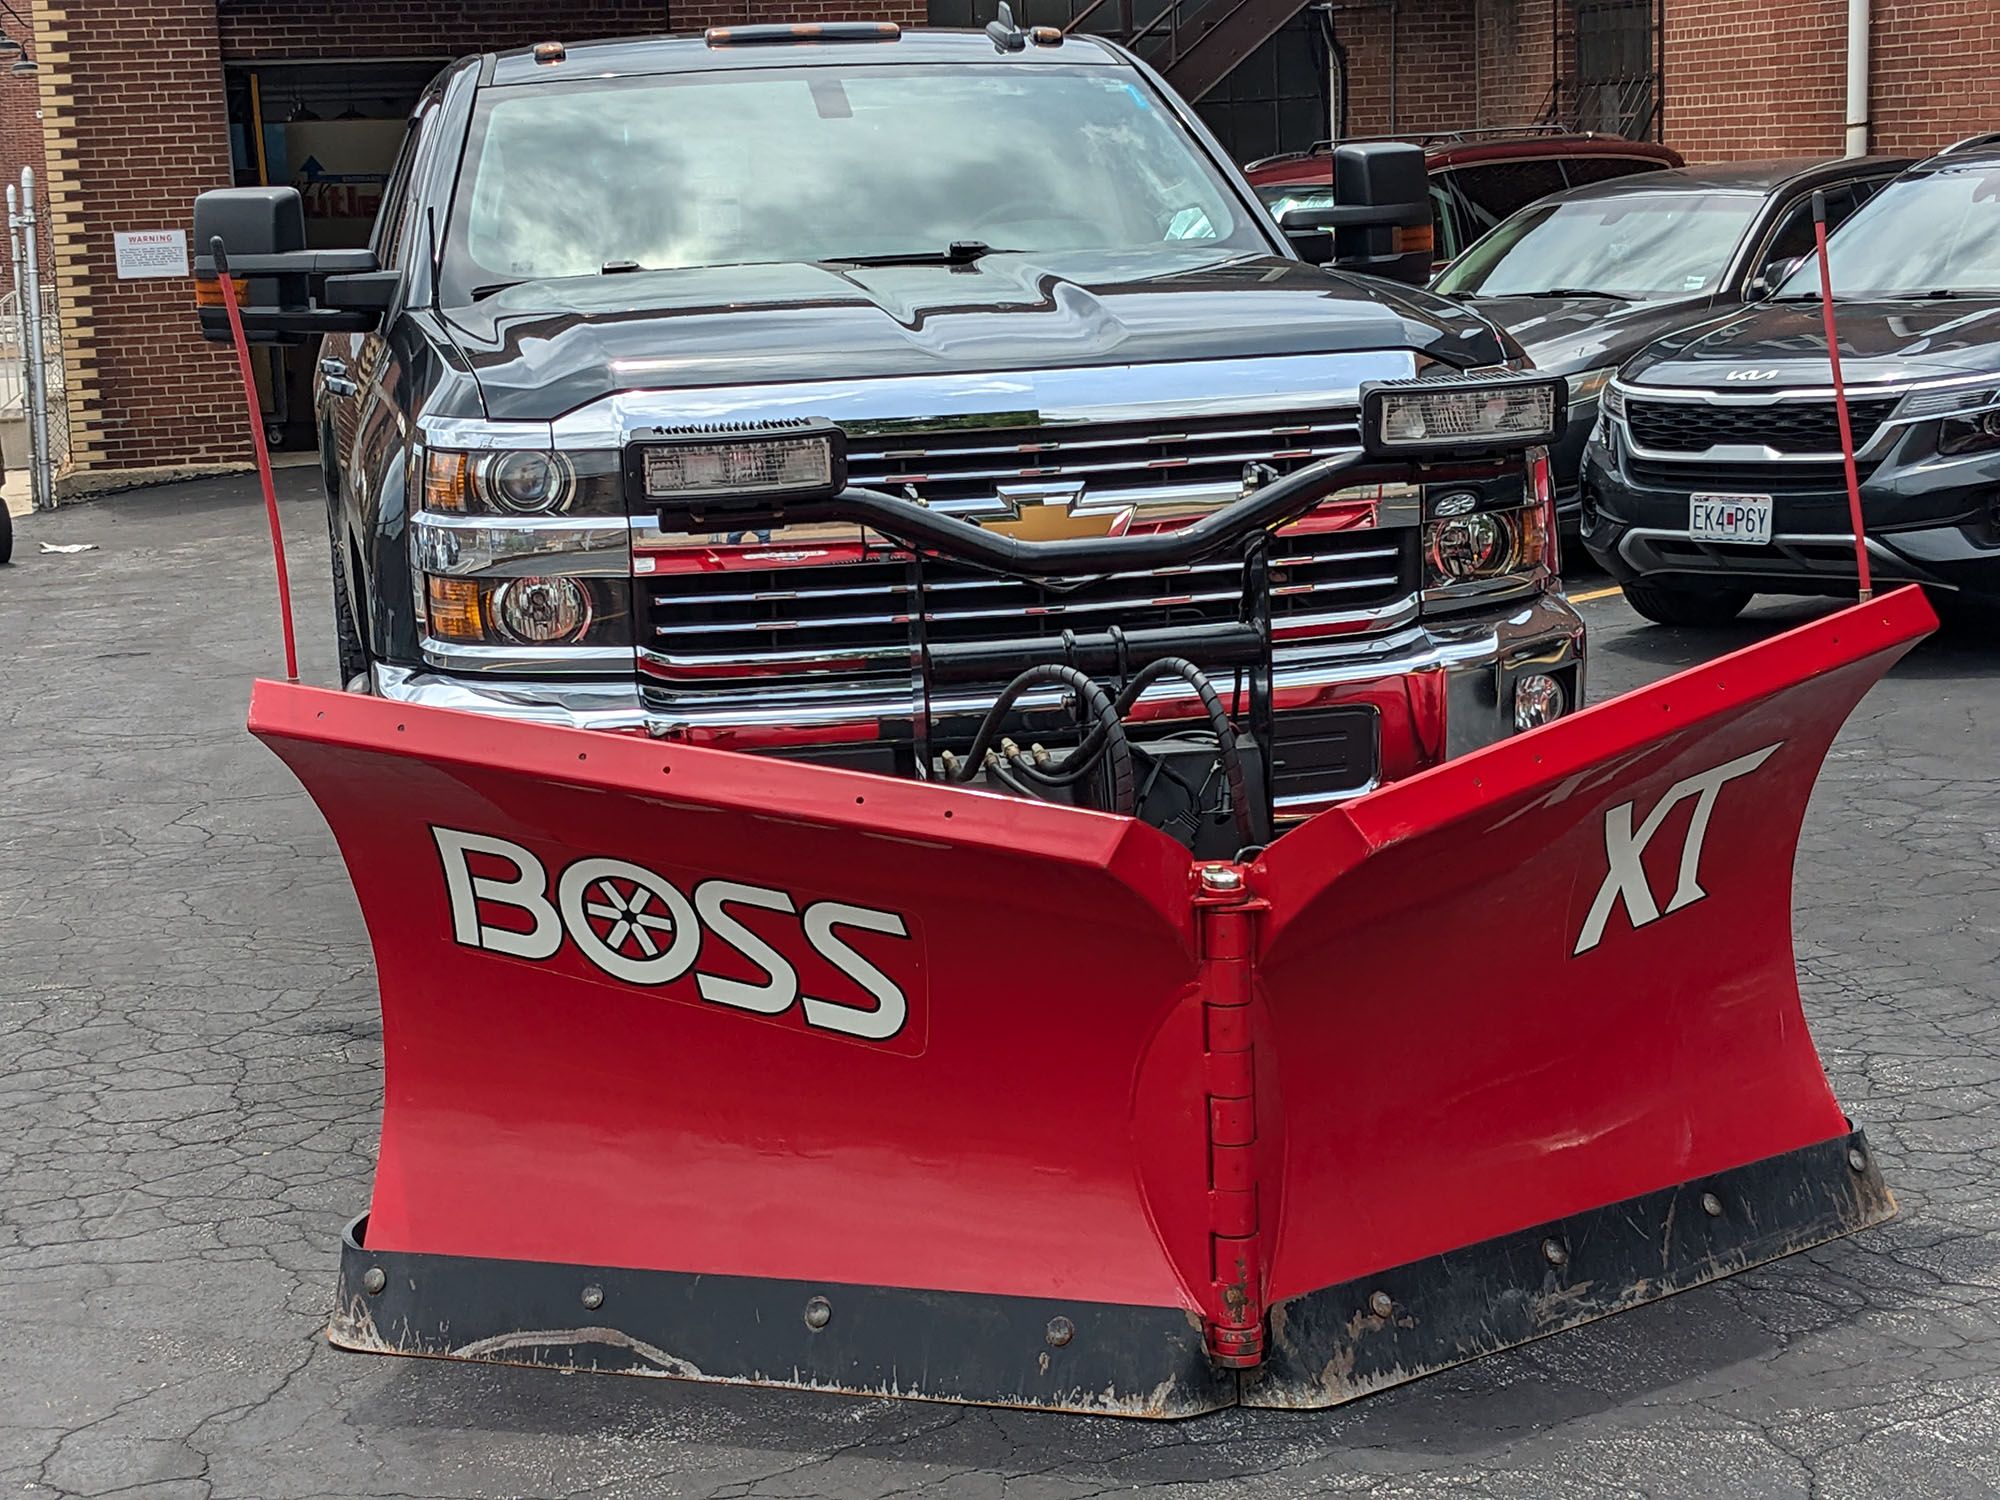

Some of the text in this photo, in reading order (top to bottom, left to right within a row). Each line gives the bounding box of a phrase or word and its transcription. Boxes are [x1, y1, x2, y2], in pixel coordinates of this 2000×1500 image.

[128, 234, 173, 243] WARNING
[430, 824, 911, 1041] BOSS
[1572, 741, 1785, 957] XT
